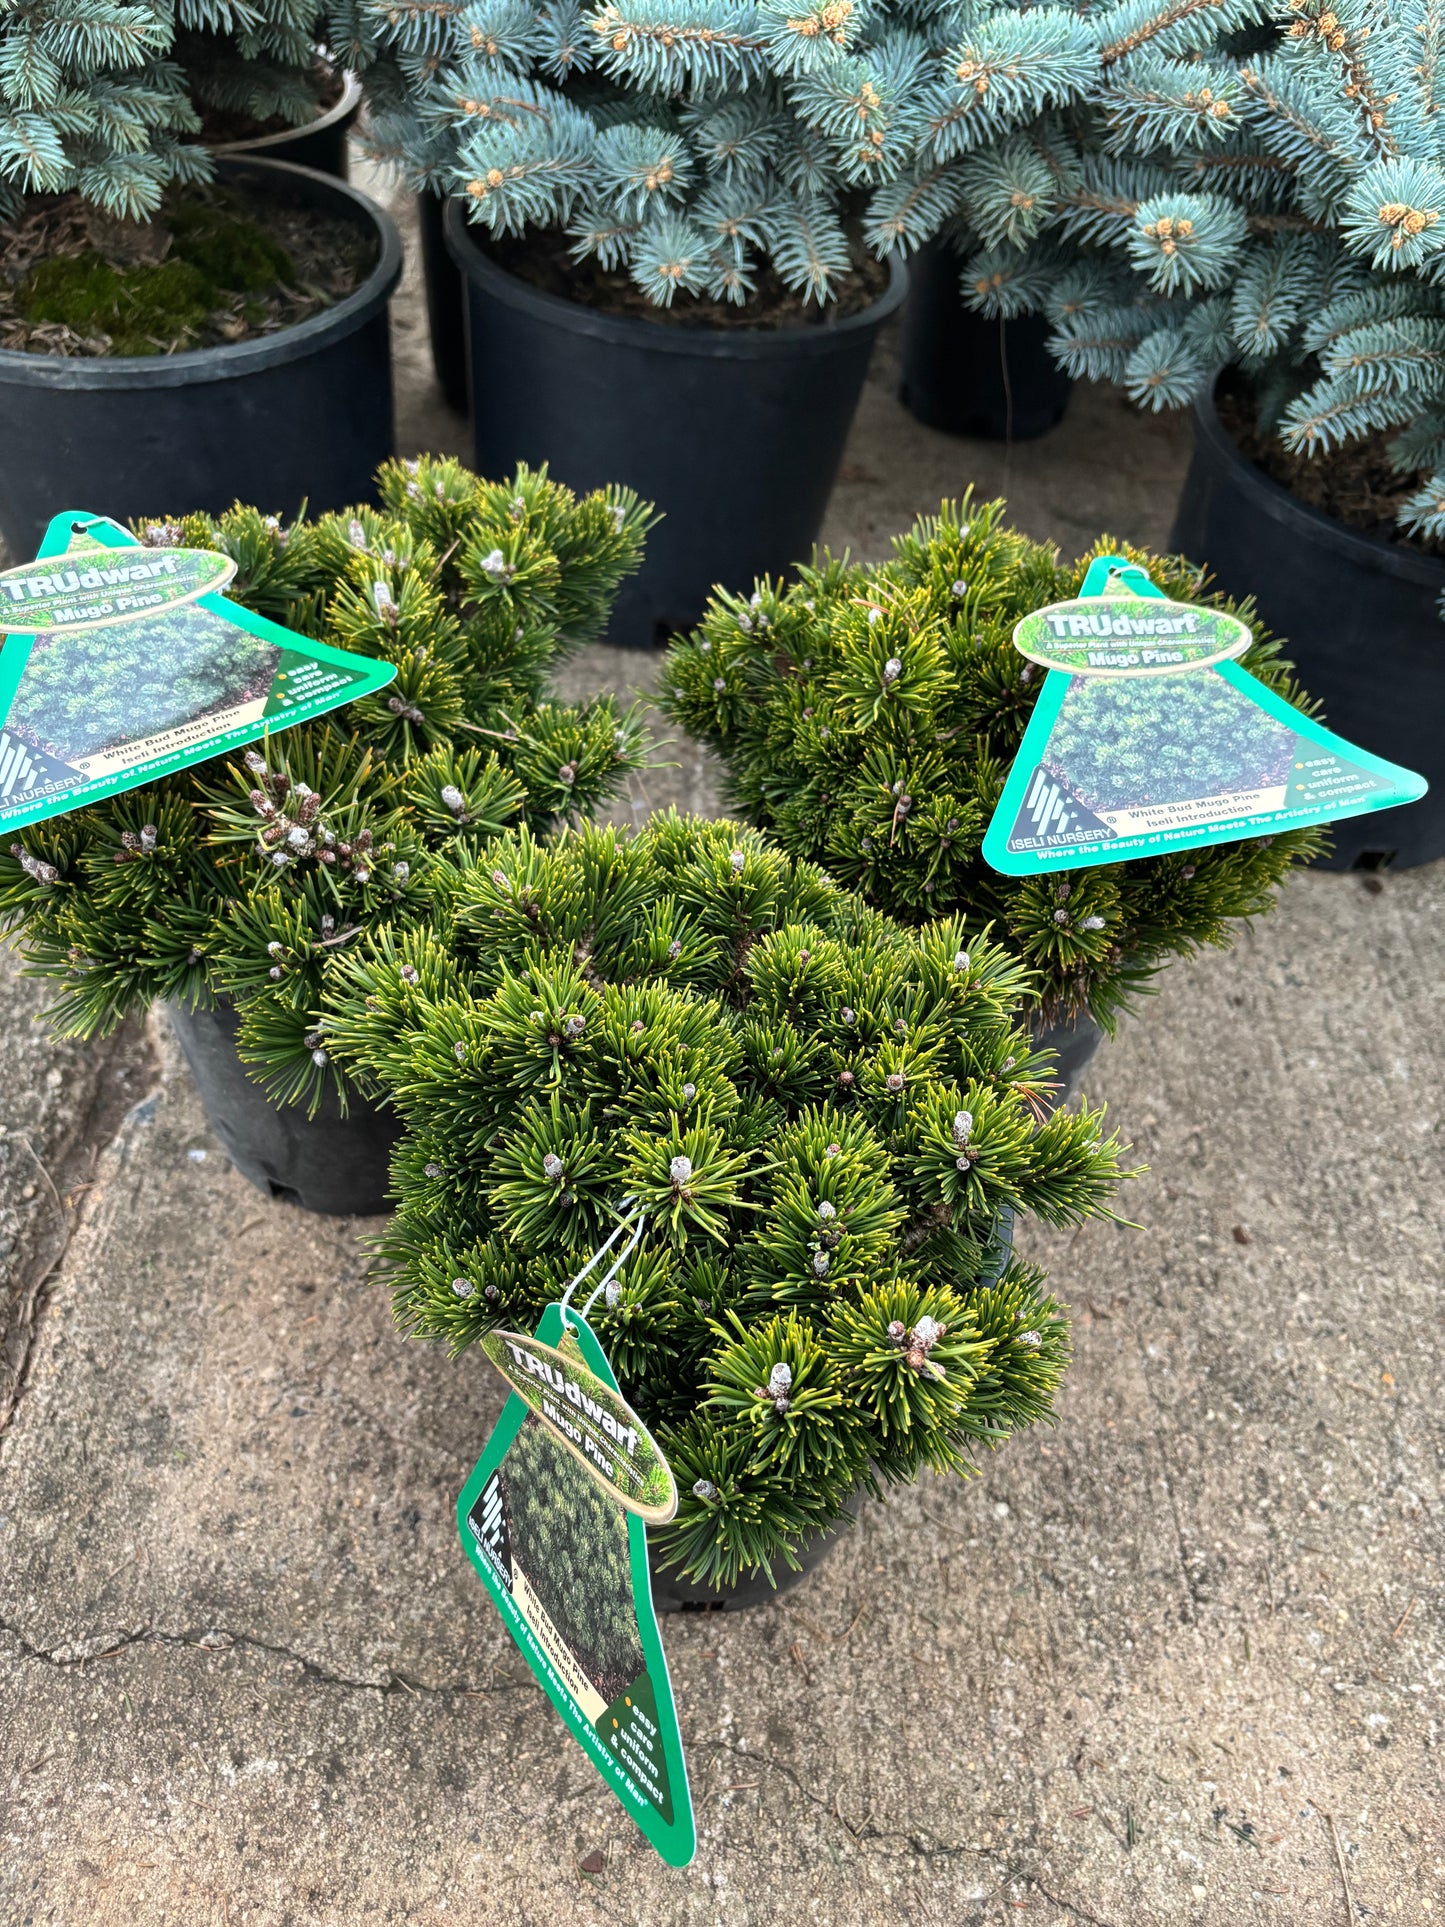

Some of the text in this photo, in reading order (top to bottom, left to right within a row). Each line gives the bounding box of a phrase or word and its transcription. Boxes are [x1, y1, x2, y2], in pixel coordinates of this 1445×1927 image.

[53, 593, 163, 623] Mugo Pine
[287, 662, 318, 676] easy
[1088, 650, 1183, 667] Mugo Pine
[282, 675, 353, 707] & compact
[287, 673, 338, 695] uniform
[293, 670, 323, 684] care
[103, 710, 241, 760] White Bud Mugo Pine
[121, 723, 231, 765] Iseli Introduction
[1, 801, 43, 821] Where
[47, 792, 69, 804] the
[72, 775, 118, 797] Beauty
[121, 770, 135, 779] of
[138, 753, 181, 774] Nature
[184, 738, 222, 757] Meets
[224, 727, 248, 740] The
[251, 709, 297, 730] Artistry
[300, 702, 312, 711] of
[1305, 756, 1337, 768] easy
[1312, 766, 1342, 778] care
[12, 773, 84, 804] NURSERY
[1303, 780, 1377, 801] & compact
[1307, 773, 1359, 789] uniform
[1128, 792, 1260, 819] White Bud Mugo Pine
[1147, 804, 1252, 828] Iseli Introduction
[1011, 827, 1112, 850] ISELI NURSERY
[1036, 849, 1075, 860] Where
[1079, 845, 1099, 854] the
[1102, 838, 1144, 851] Beauty
[1148, 834, 1161, 843] of
[1164, 827, 1205, 841] Nature
[1208, 821, 1247, 833] Meets
[1249, 815, 1273, 825] The
[1275, 807, 1320, 821] Artistry
[1324, 801, 1337, 810] of
[542, 1399, 614, 1477] Mugo Pine
[468, 1515, 512, 1587] ISELI NURSERY
[524, 1581, 589, 1691] White Bud Mugo Pine
[526, 1605, 579, 1695] Iseli Introduction
[475, 1543, 491, 1574] Where
[501, 1591, 520, 1624] Beauty
[526, 1632, 547, 1669] Nature
[547, 1667, 567, 1702] Meets
[568, 1699, 582, 1724] The
[583, 1723, 614, 1767] Artistry
[630, 1721, 654, 1751] care
[632, 1705, 657, 1737] easy
[620, 1728, 658, 1778] uniform
[620, 1748, 664, 1804] compact
